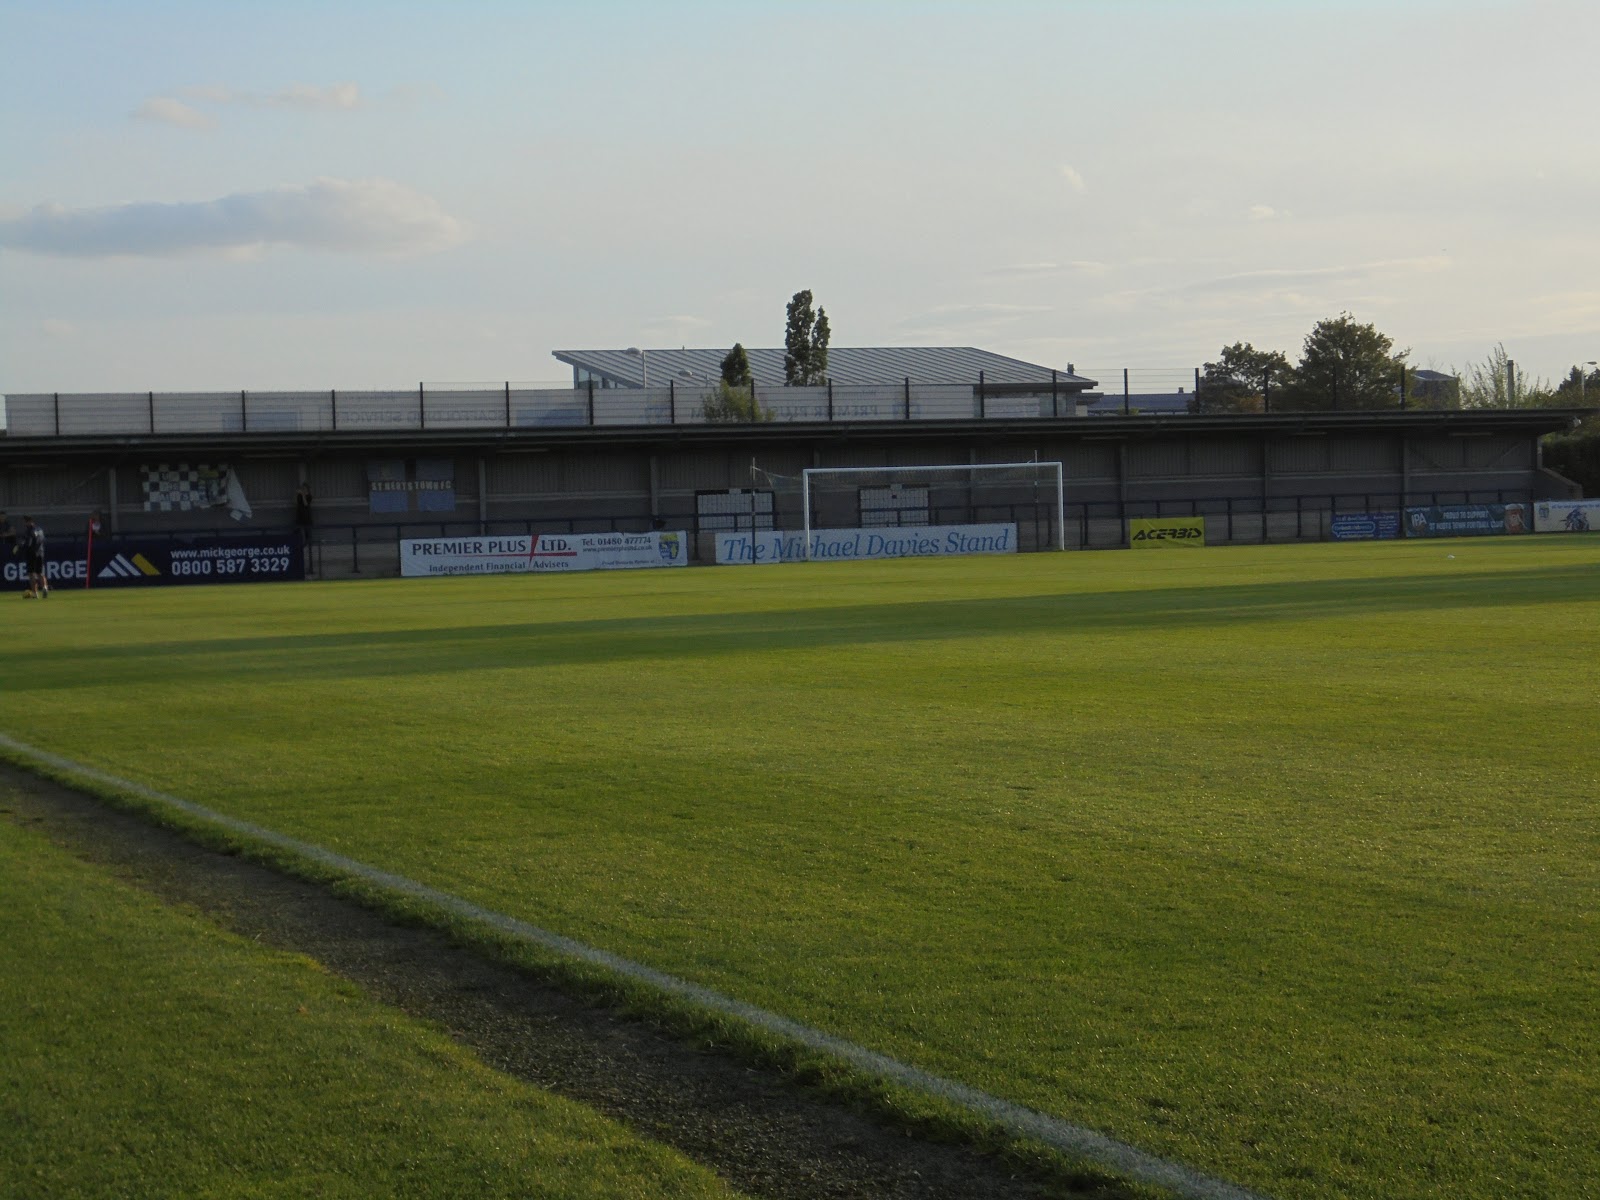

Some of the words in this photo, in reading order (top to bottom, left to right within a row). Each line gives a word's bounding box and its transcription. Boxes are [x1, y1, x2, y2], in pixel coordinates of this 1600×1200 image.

[1411, 512, 1428, 527] IPA
[412, 540, 483, 556] PREMIER
[488, 539, 526, 553] PLUS
[541, 538, 572, 552] LTD.
[597, 537, 622, 546] 01480
[724, 537, 766, 562] The
[770, 533, 861, 560] Michael
[867, 532, 940, 557] Davies
[945, 528, 1009, 554] Stand
[170, 545, 290, 559] www.mickgeorge.co.uk
[3, 560, 88, 581] GERGE
[171, 560, 212, 576] 0800
[216, 559, 245, 574] 587
[250, 557, 290, 573] 3329
[429, 563, 484, 573] Independent
[486, 561, 526, 571] Financial
[532, 560, 569, 570] Advisers
